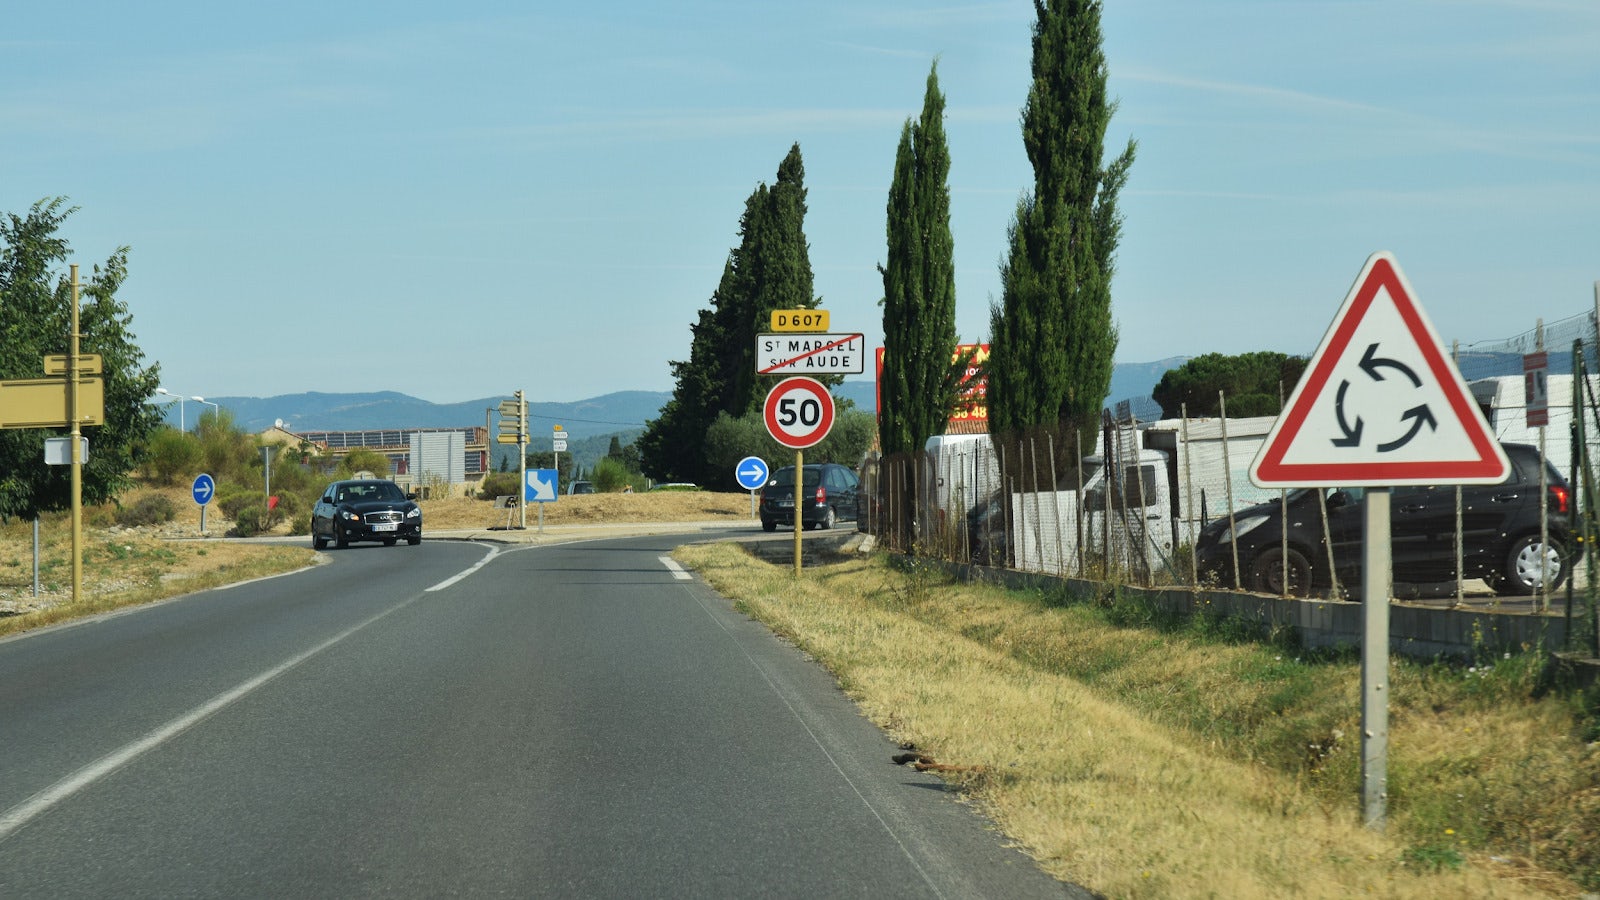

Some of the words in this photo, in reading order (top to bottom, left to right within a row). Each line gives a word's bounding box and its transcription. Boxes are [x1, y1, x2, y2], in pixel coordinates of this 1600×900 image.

[778, 315, 787, 326] D
[792, 315, 822, 326] 607
[788, 340, 856, 352] MARCEL
[806, 356, 850, 368] AUDE
[778, 398, 820, 426] 50
